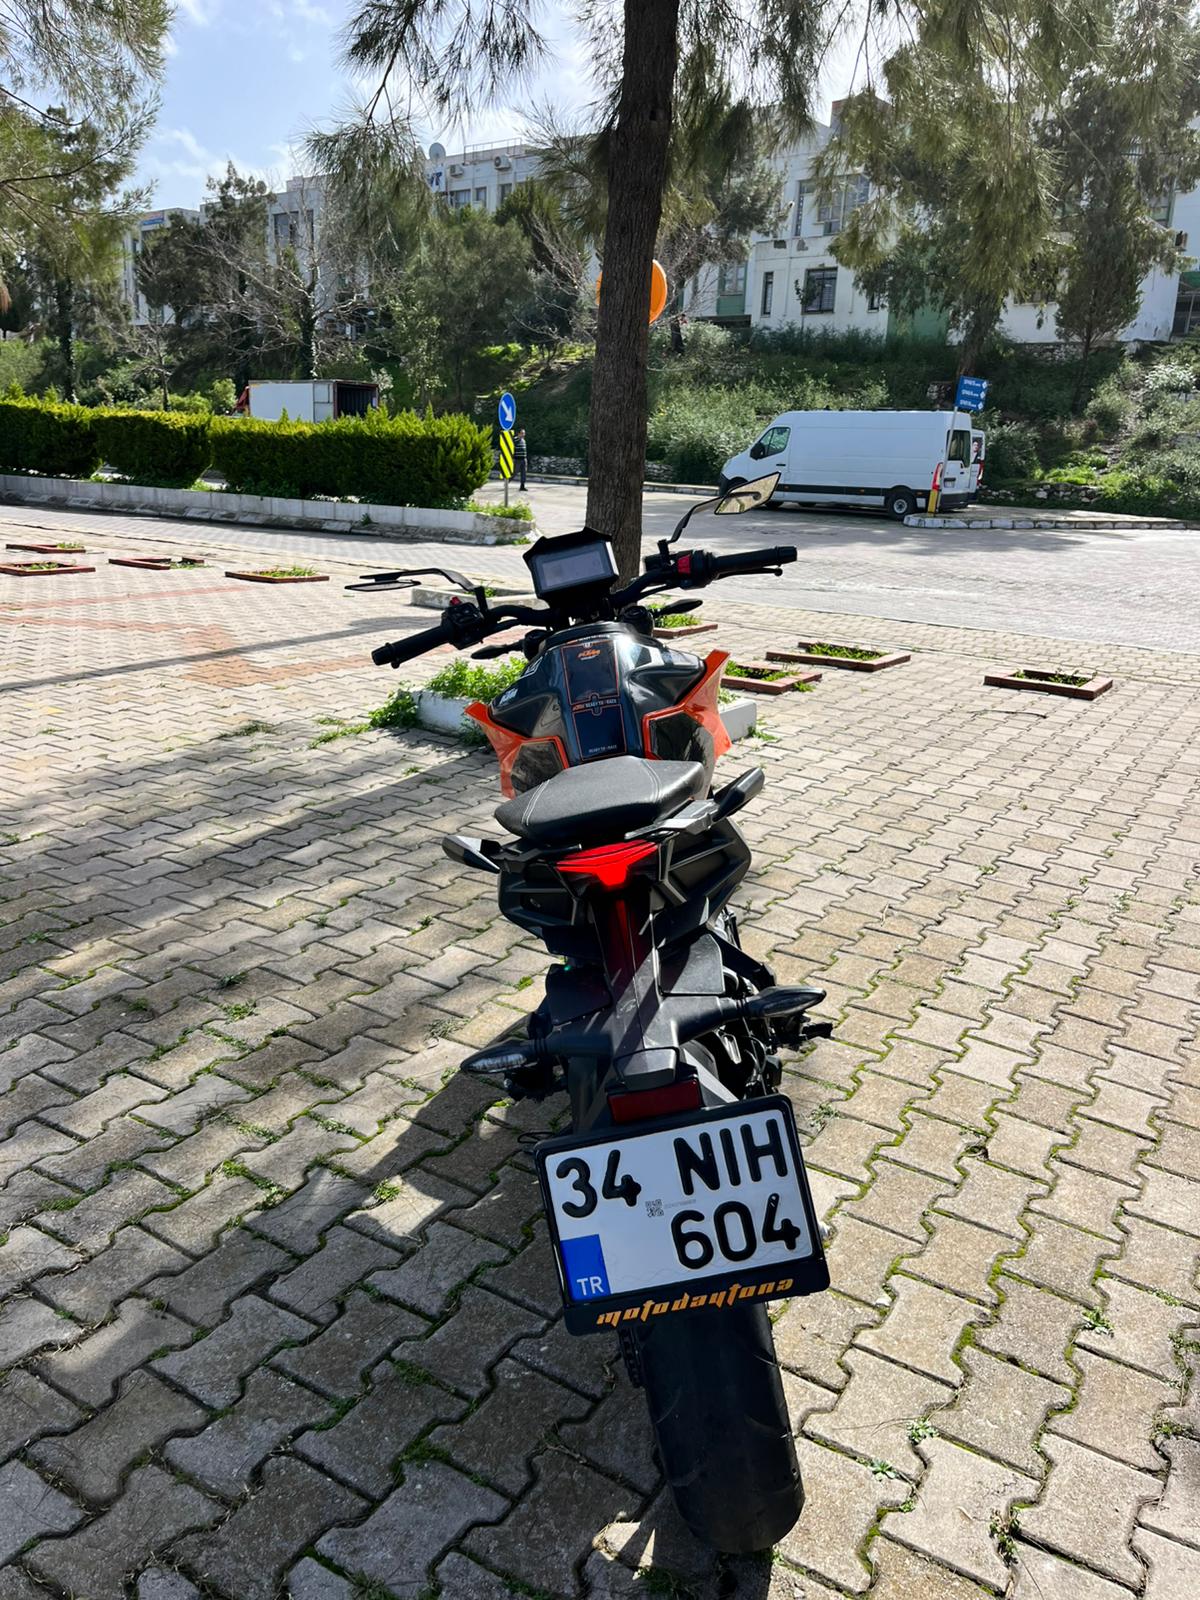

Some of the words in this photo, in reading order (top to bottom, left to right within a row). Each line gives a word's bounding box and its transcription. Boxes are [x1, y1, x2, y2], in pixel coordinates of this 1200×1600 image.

[556, 1149, 642, 1218] 34
[673, 1118, 788, 1196] NIH
[670, 1192, 801, 1270] 604
[577, 1276, 604, 1296] TR
[596, 1278, 794, 1328] motodaytona
